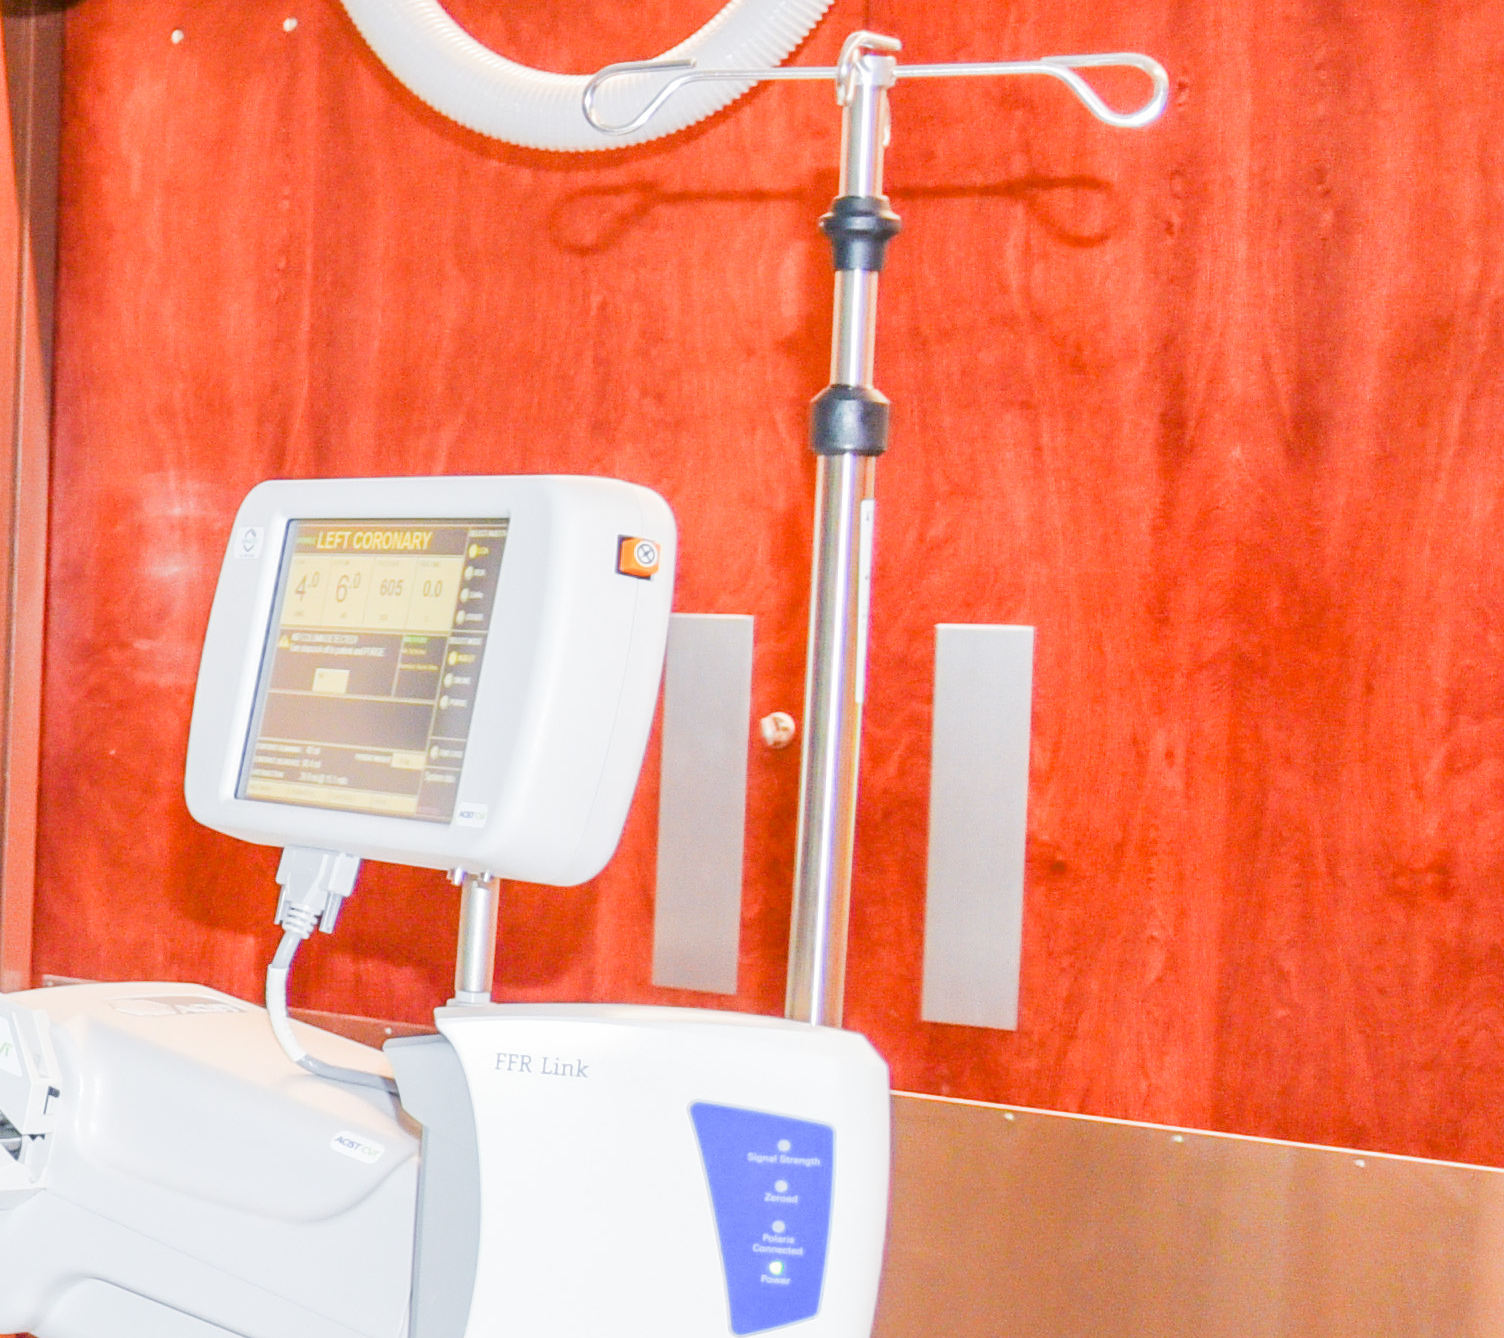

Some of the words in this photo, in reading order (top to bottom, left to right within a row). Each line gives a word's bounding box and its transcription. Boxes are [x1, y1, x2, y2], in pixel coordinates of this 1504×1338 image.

[317, 531, 349, 550] LEFT
[352, 531, 433, 551] CORONARY
[379, 579, 403, 597] 605
[422, 580, 443, 598] 0.0
[494, 1052, 532, 1073] FFR
[540, 1056, 589, 1078] Link
[747, 1152, 777, 1164] Signal
[779, 1154, 820, 1167] Strength
[764, 1192, 798, 1204] Zeroed
[762, 1233, 795, 1244] Polaris
[752, 1243, 804, 1256] Connected
[760, 1274, 791, 1286] Power
